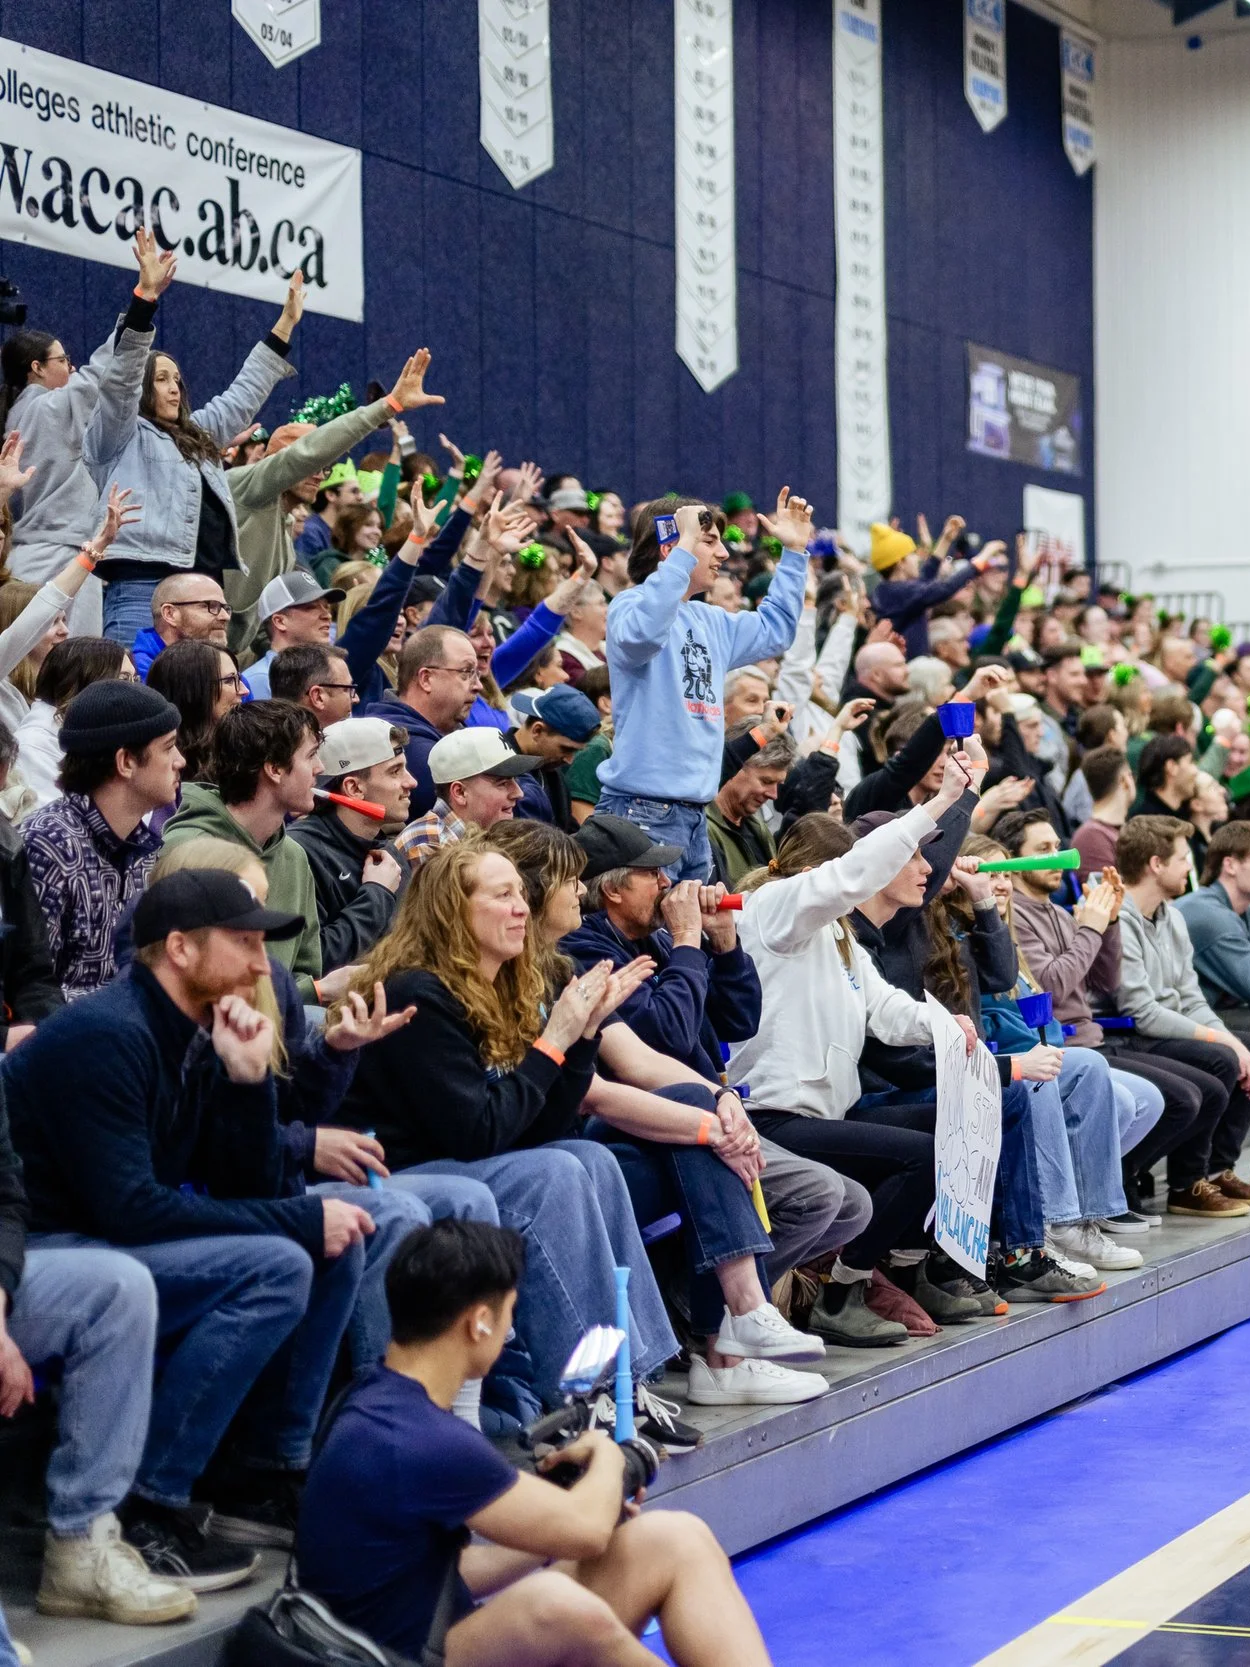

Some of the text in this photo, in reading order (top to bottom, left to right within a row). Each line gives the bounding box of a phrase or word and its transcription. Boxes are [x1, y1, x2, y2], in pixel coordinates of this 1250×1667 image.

[260, 23, 293, 48] 03/04
[91, 99, 177, 152] athletic
[186, 130, 306, 190] conference
